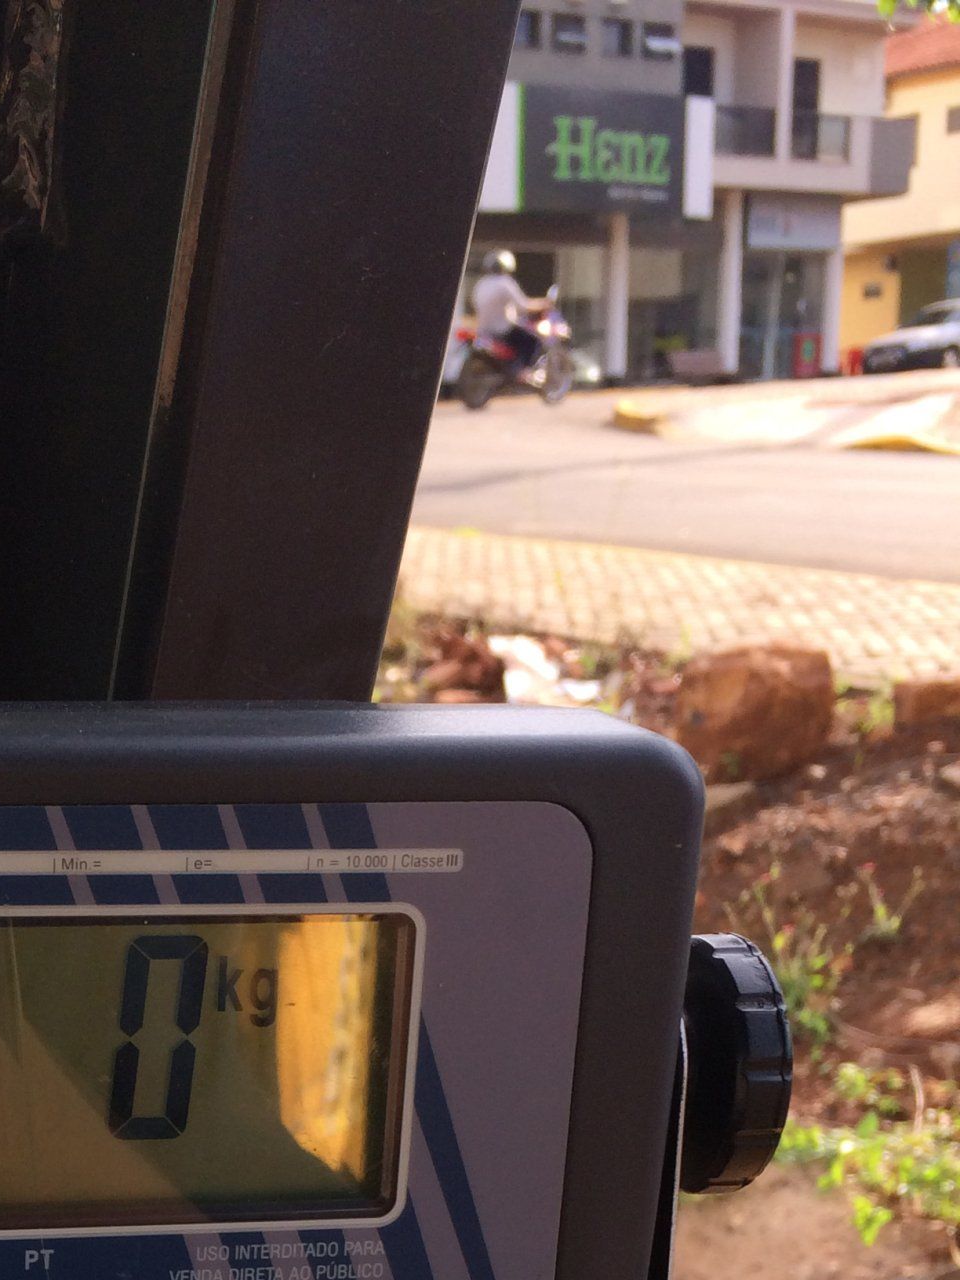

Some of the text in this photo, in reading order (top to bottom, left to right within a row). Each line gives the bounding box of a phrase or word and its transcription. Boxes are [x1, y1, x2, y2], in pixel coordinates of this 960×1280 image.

[108, 935, 279, 1140] 0 kg
[25, 1249, 55, 1270] PT
[197, 1240, 385, 1261] USO INTERDITADO PARA
[289, 1265, 312, 1280] AO
[316, 1261, 384, 1280] PÚBLICO
